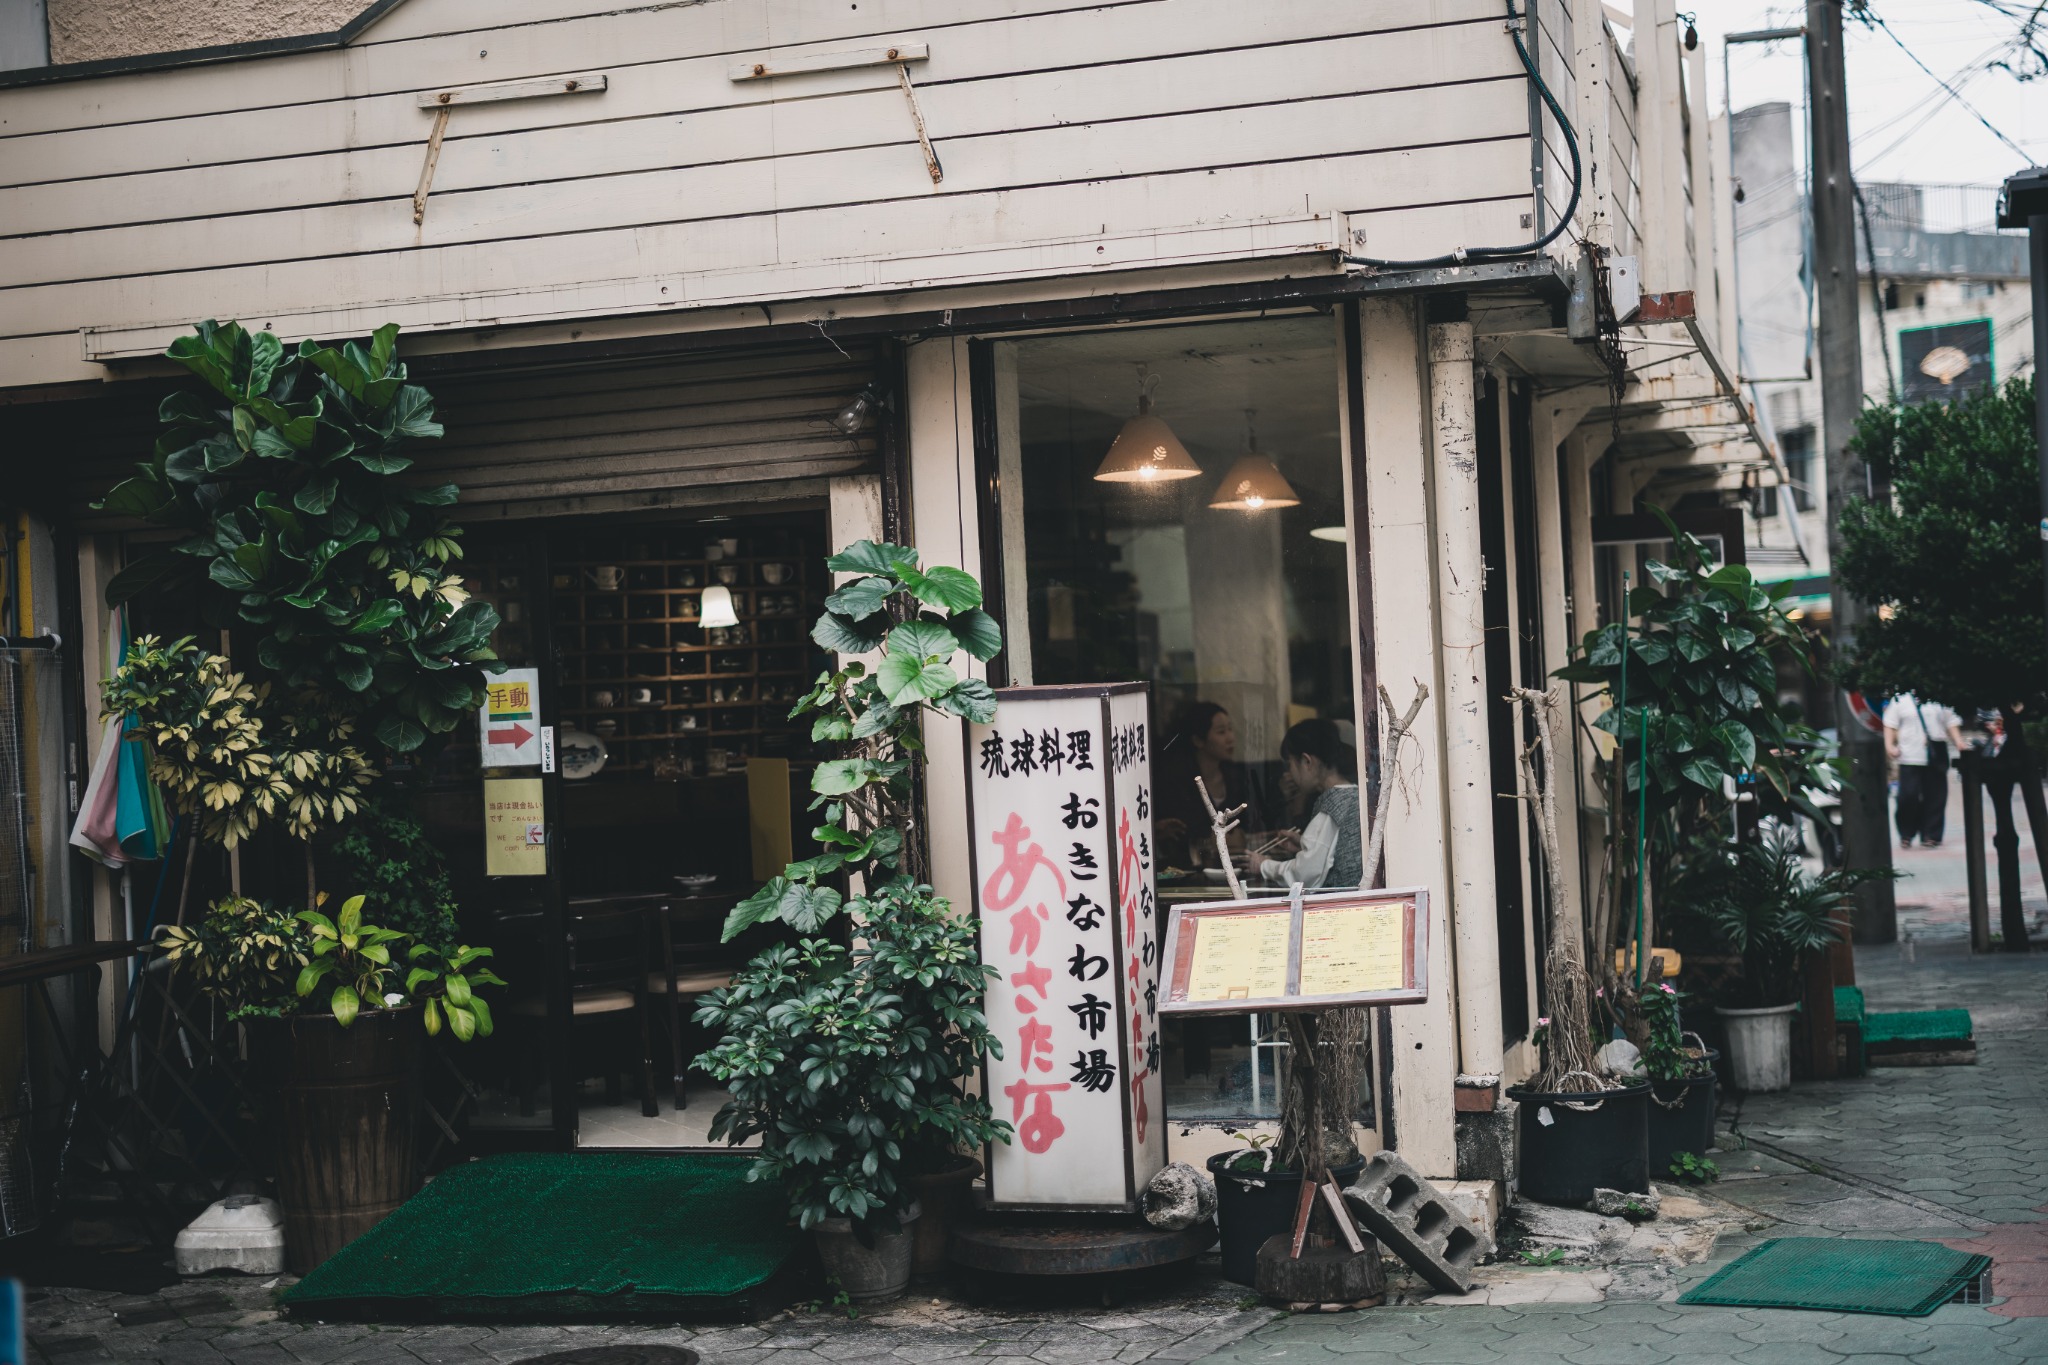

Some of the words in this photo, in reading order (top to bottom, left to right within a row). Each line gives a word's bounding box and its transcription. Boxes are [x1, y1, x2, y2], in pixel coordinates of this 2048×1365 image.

[490, 687, 529, 708] 手動
[980, 727, 1094, 779] 琉球料理
[489, 801, 543, 811] 当店は現金払い
[490, 814, 503, 822] です
[982, 811, 1072, 1155] あかさたな
[1060, 792, 1117, 1094] おきなわ市場
[1118, 806, 1150, 1146] あかさたな
[1135, 784, 1160, 1076] おきなわ市場
